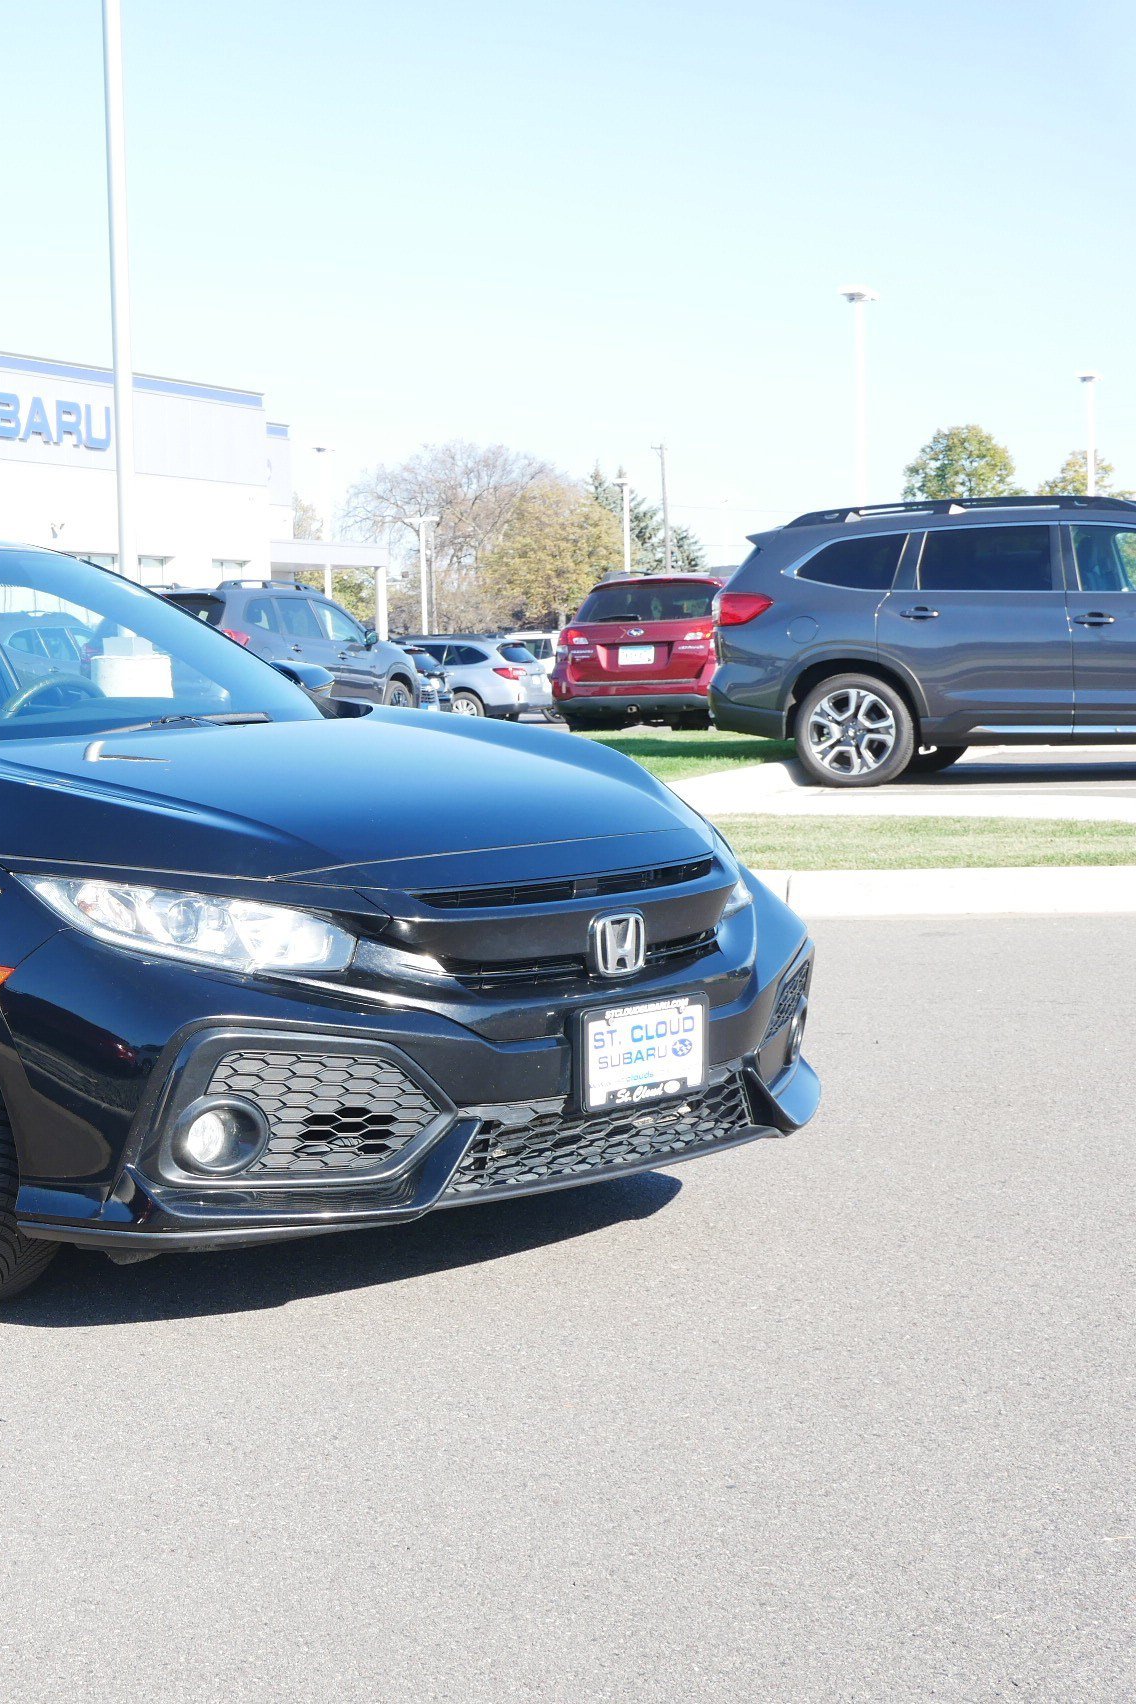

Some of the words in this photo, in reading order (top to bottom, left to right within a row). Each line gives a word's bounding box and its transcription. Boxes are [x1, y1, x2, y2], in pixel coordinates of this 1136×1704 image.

[593, 1029, 621, 1050] ST.
[630, 1016, 695, 1043] CLOUD
[598, 1045, 668, 1070] SUBARU
[632, 1083, 664, 1103] Cloud
